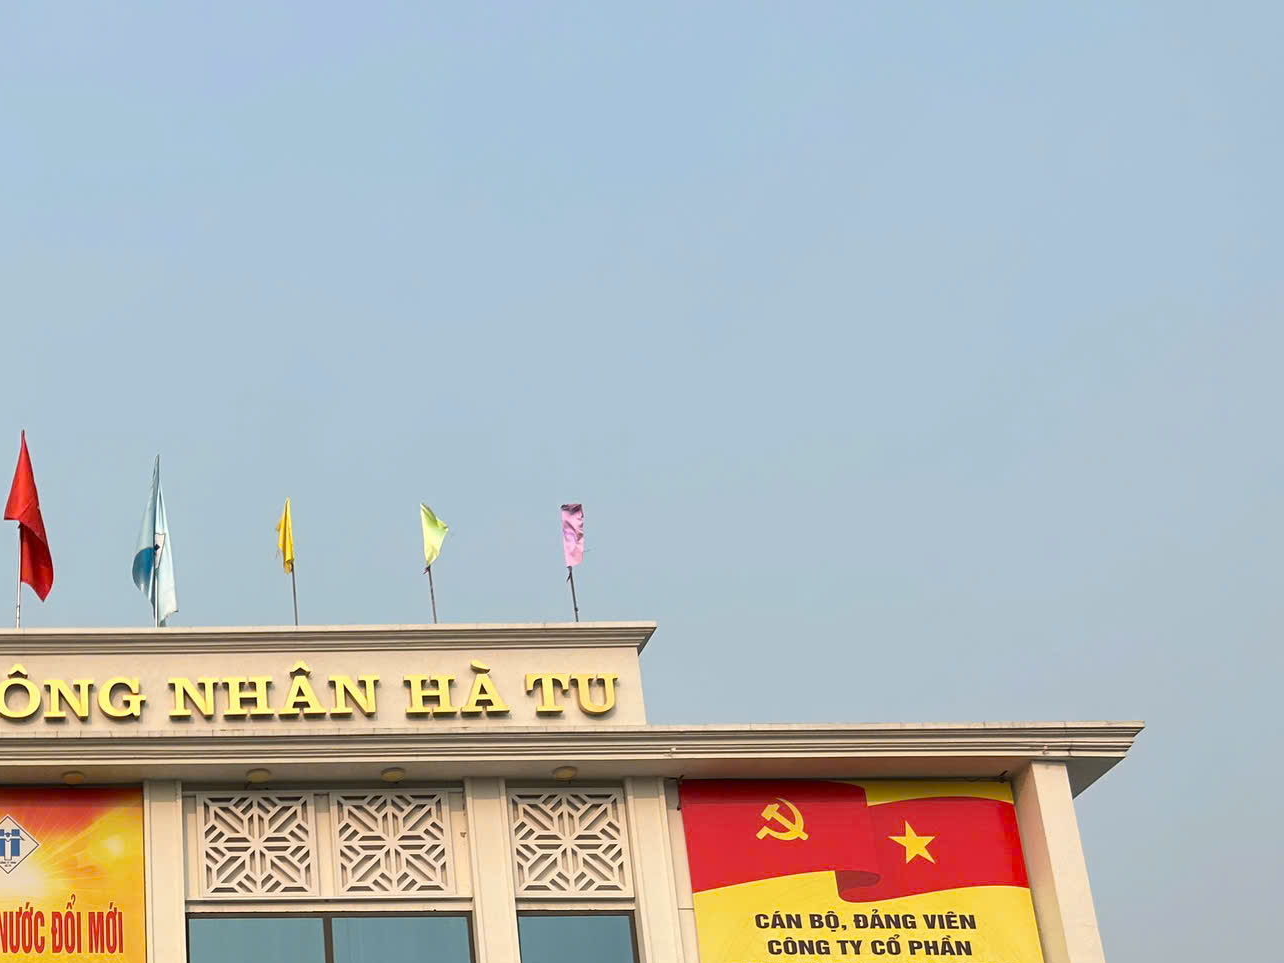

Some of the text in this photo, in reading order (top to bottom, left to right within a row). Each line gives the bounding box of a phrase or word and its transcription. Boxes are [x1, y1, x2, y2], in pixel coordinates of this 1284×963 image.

[169, 664, 379, 718] NHÂN
[404, 660, 510, 715] HÀ
[525, 672, 619, 715] TU
[51, 893, 82, 953] ĐỔI
[88, 902, 124, 953] MỚI
[755, 908, 977, 932] CÁN BỘ, ĐẢNG VIÊN
[767, 934, 973, 956] CÔNG TY CỔ PHẦN
